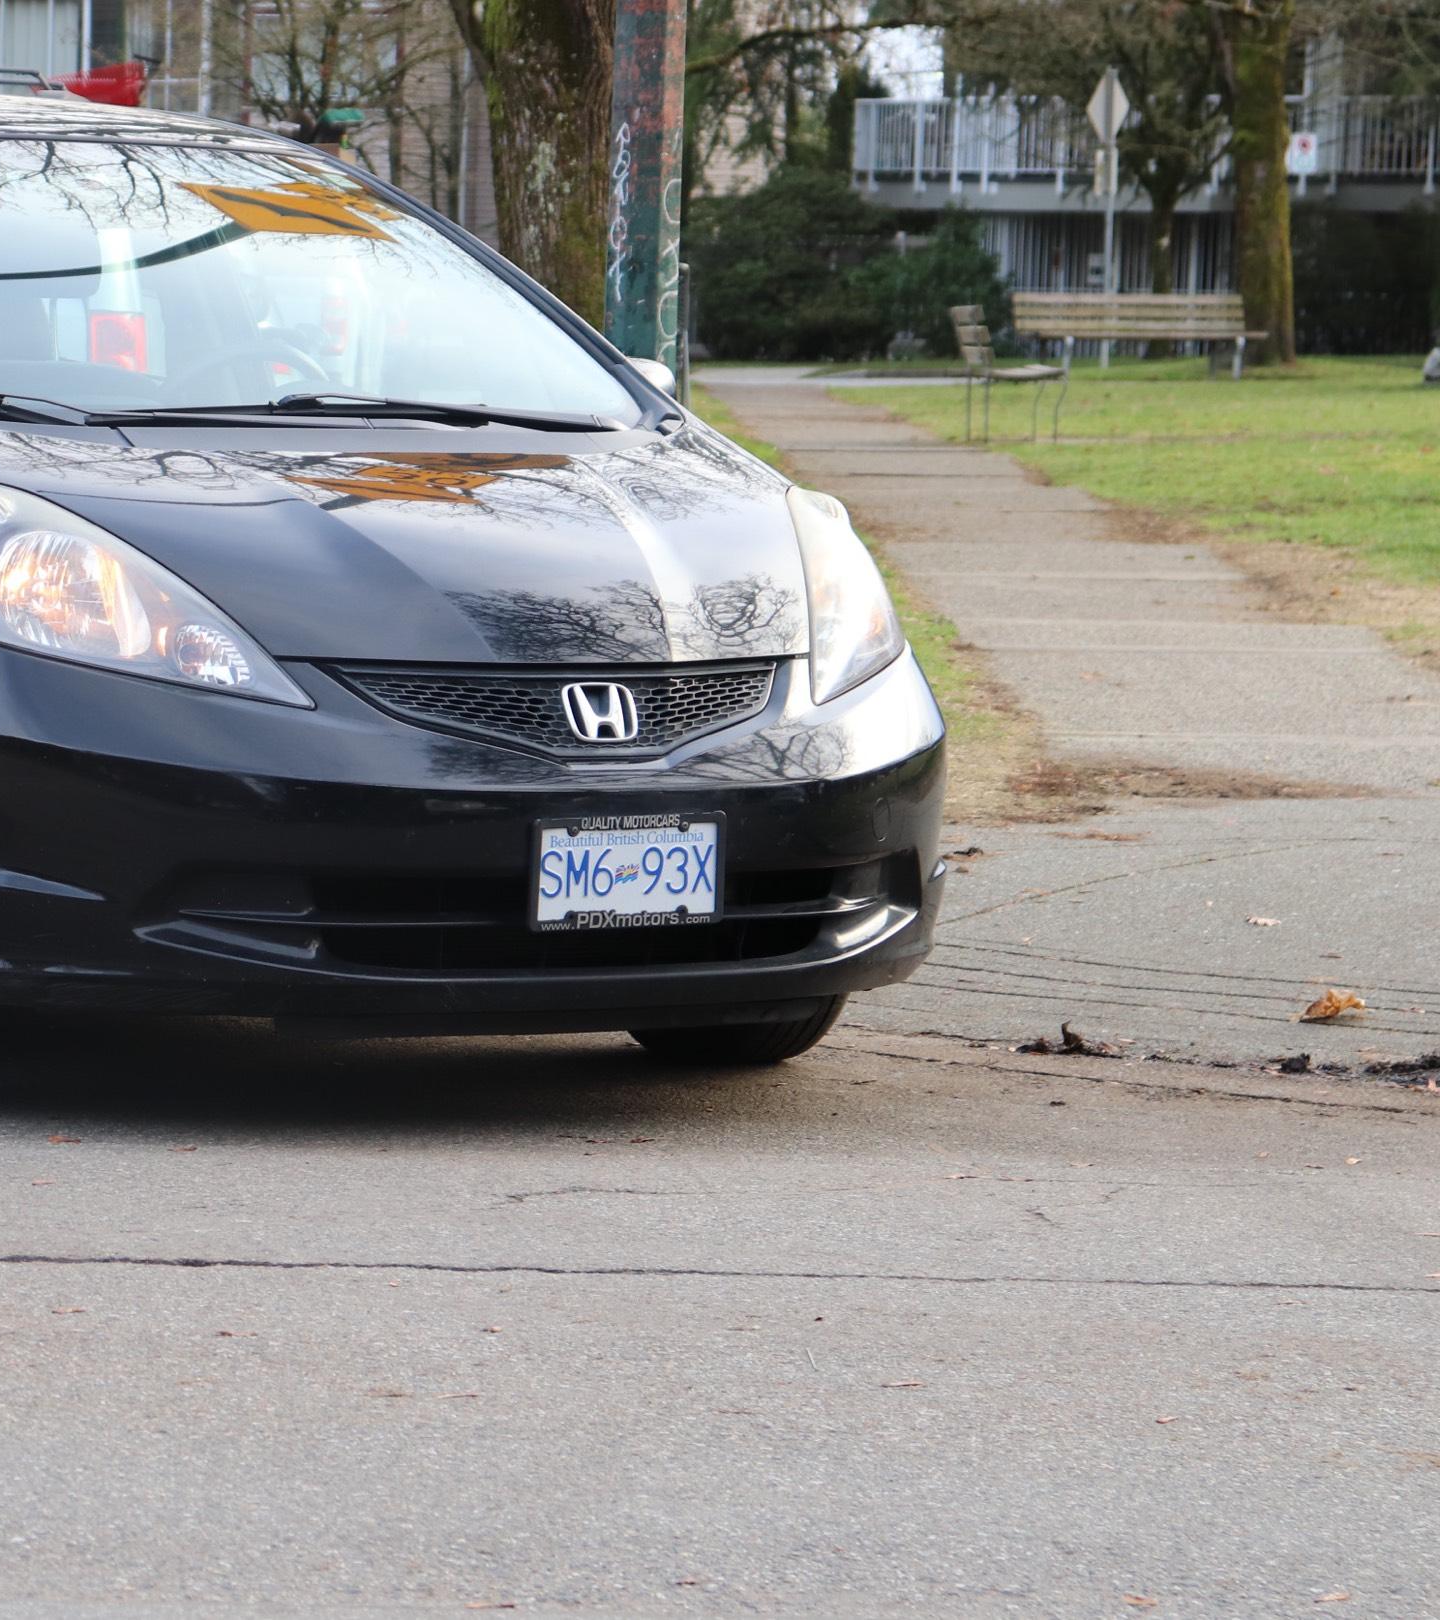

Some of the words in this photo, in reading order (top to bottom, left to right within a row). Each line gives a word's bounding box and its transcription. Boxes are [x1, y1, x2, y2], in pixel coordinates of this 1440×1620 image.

[581, 816, 620, 830] QUALITY
[623, 814, 681, 829] MOTORCARS
[550, 833, 603, 848] Beautiful
[608, 830, 645, 846] British
[647, 829, 704, 844] Columbia
[540, 911, 710, 931] www.PDXmotors.com
